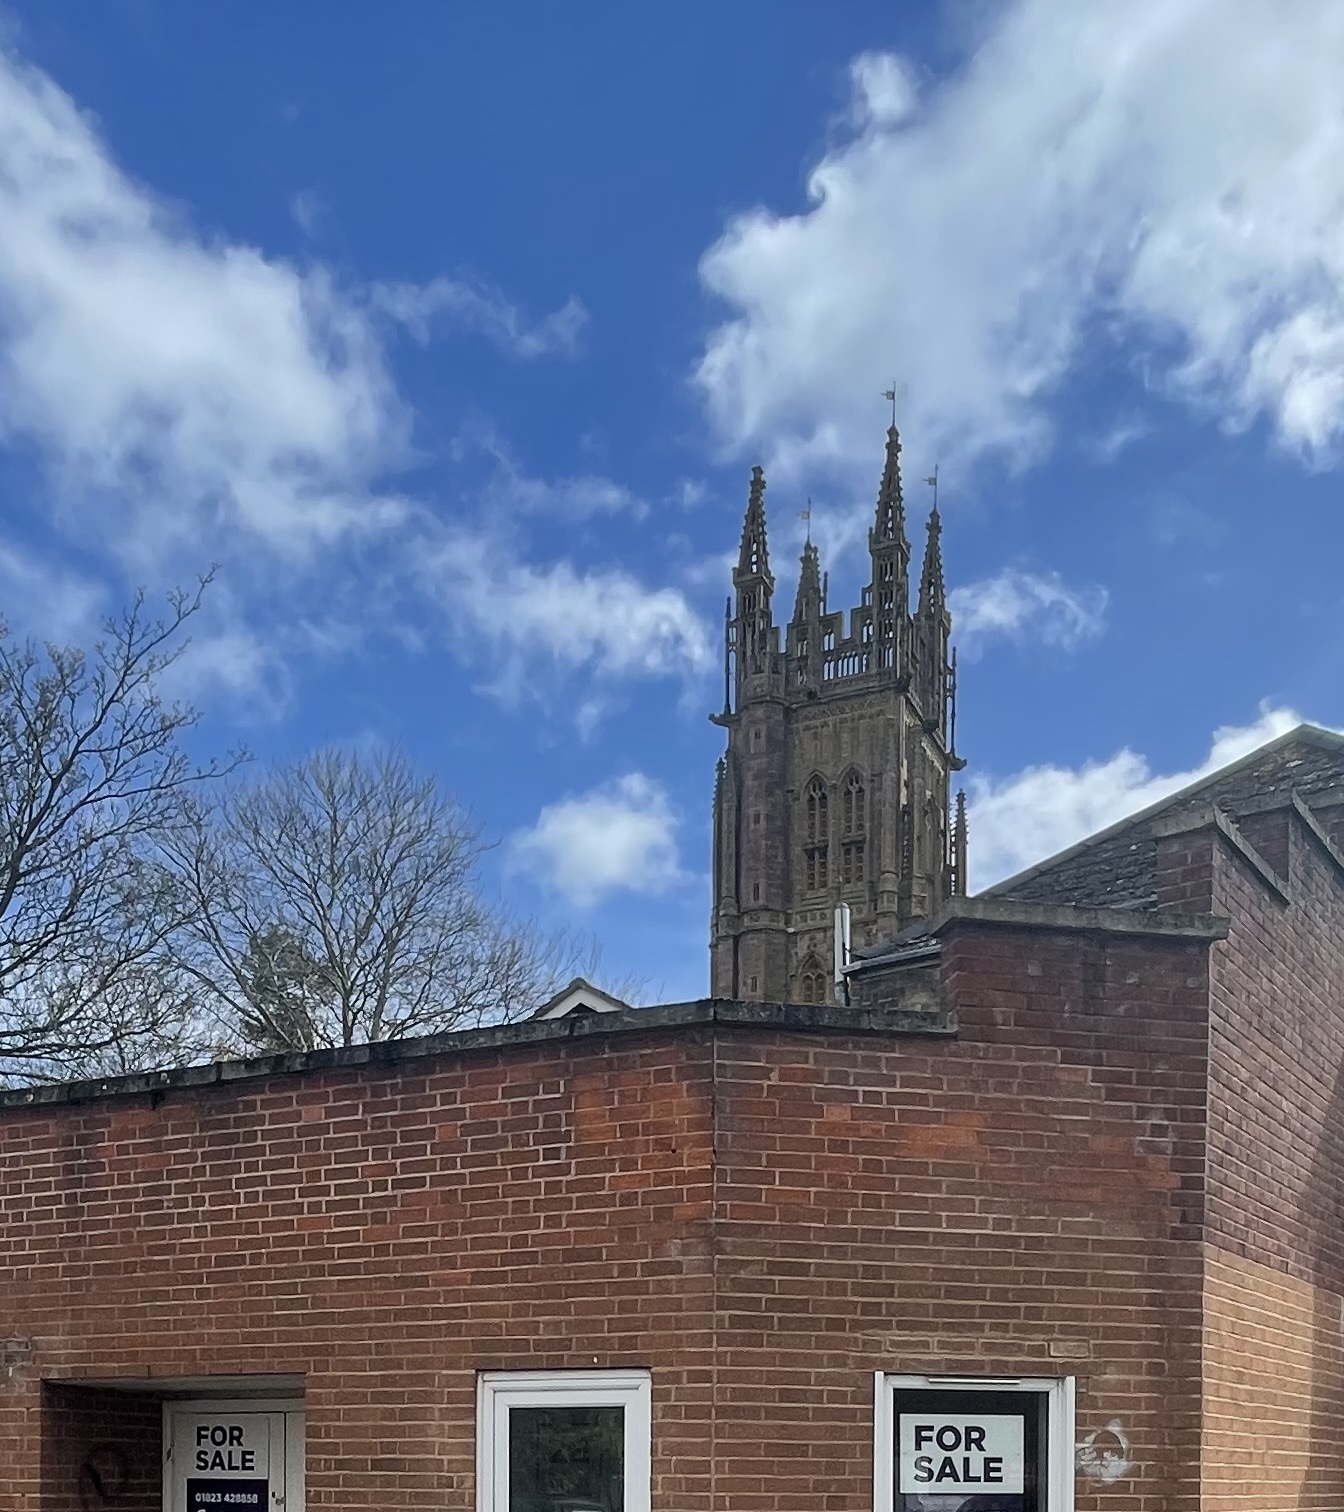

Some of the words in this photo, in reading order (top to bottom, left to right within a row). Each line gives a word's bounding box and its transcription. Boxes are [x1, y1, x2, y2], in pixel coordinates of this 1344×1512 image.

[196, 1425, 244, 1447] FOR
[914, 1425, 987, 1452] FOR
[195, 1449, 255, 1471] SALE
[913, 1456, 1004, 1483] SALE
